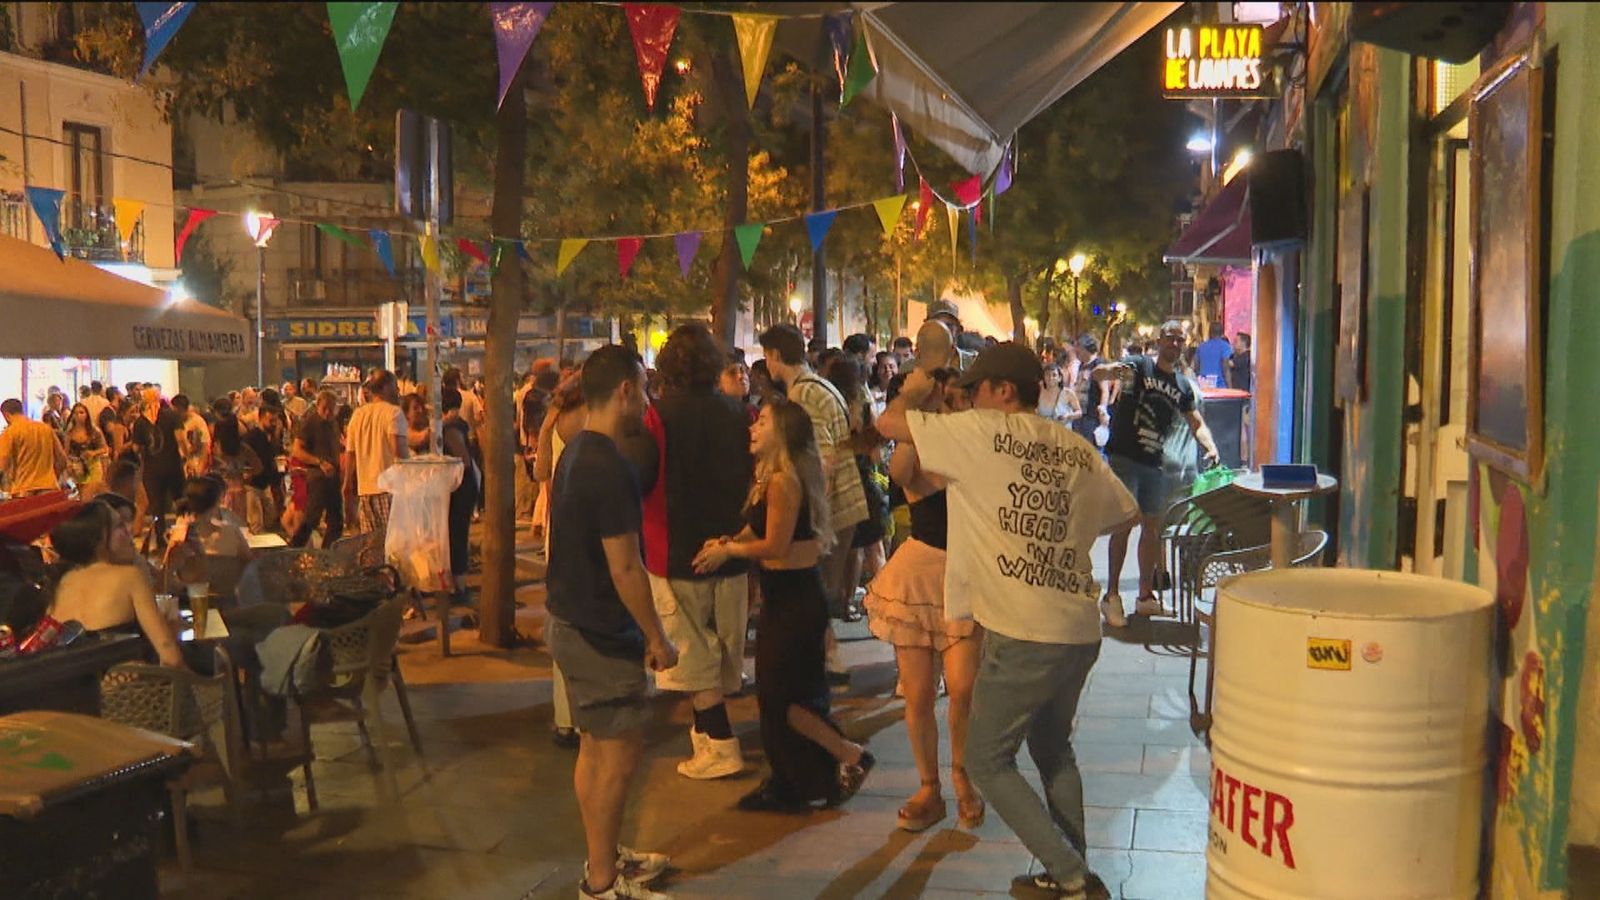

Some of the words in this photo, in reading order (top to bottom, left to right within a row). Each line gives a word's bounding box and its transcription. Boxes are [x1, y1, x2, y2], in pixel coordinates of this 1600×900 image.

[1166, 28, 1191, 59] LA
[1199, 27, 1260, 59] PLAYA
[1165, 58, 1186, 90] DE
[132, 325, 186, 352] CERVEZAS
[188, 329, 245, 354] ALHAMBRA
[1021, 463, 1065, 488] GOT
[1008, 482, 1070, 516] YOUR
[999, 507, 1067, 542] HEAD
[1027, 543, 1055, 567] IN
[1060, 548, 1076, 570] A
[1211, 766, 1296, 870] ATER
